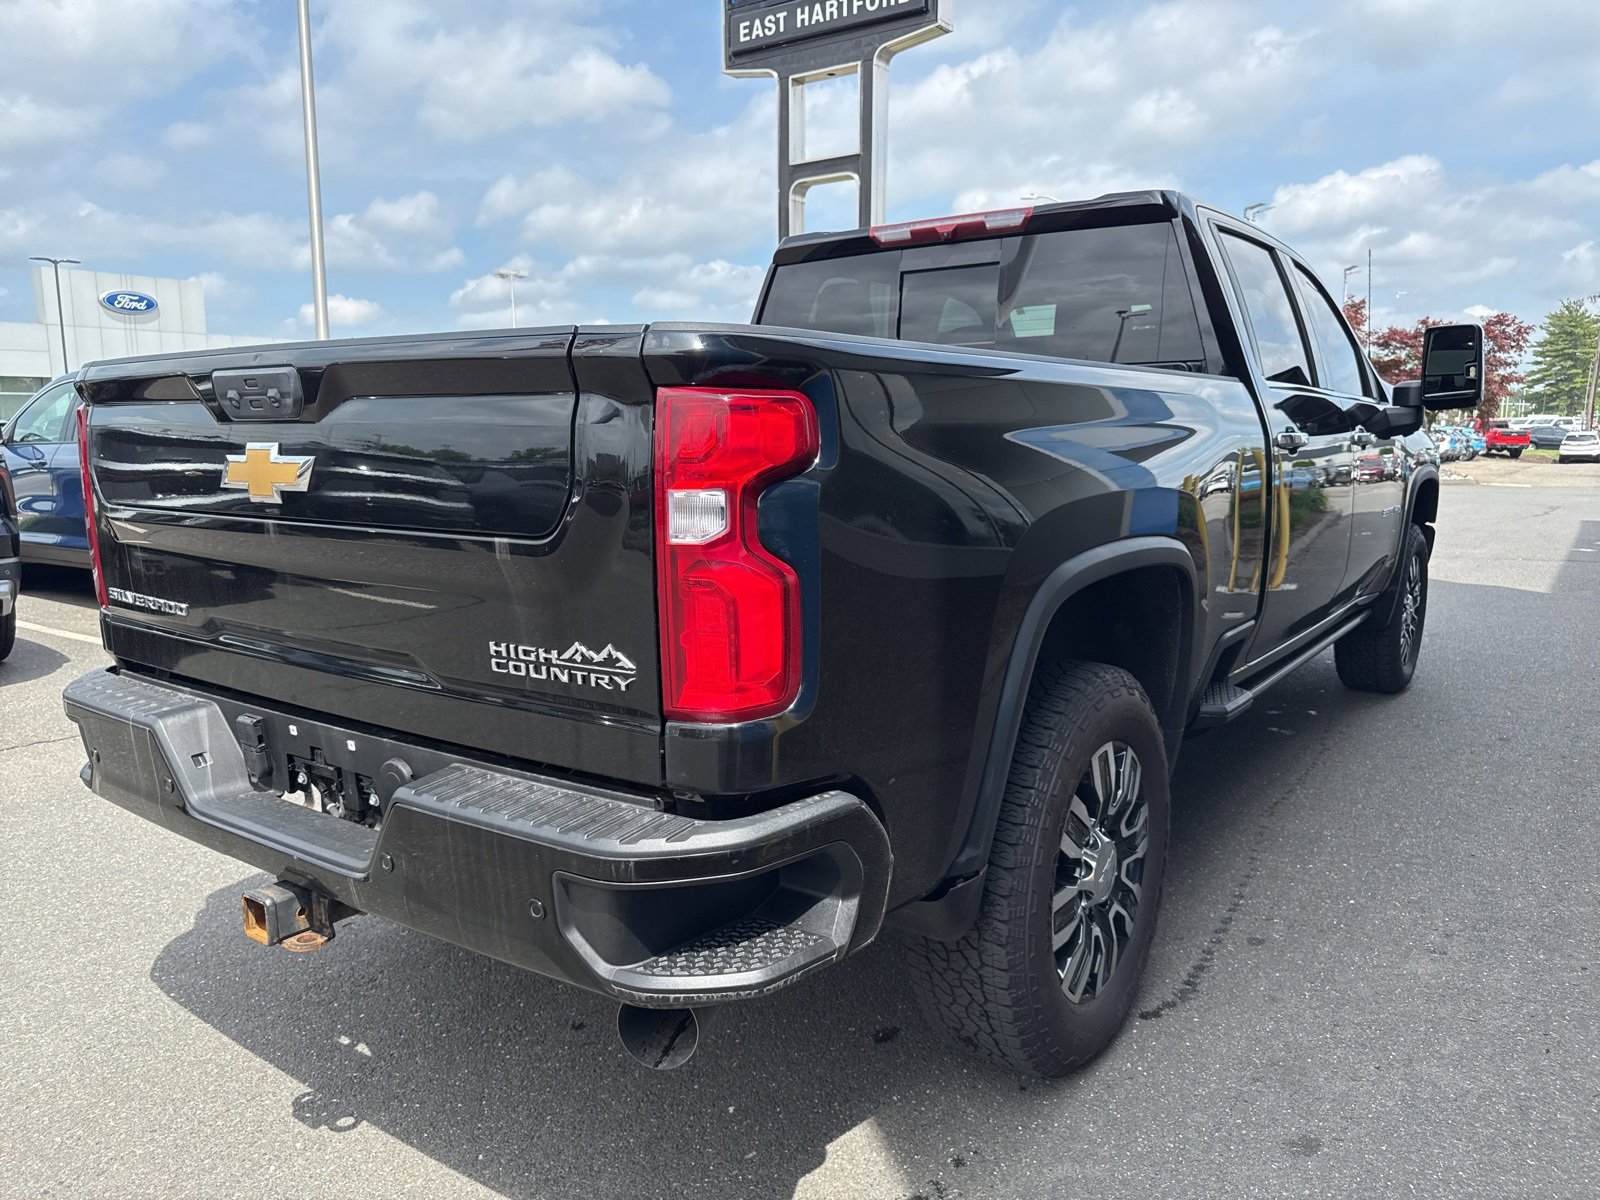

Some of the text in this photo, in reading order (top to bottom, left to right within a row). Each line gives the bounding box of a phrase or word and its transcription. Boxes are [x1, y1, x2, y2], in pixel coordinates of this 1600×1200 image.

[739, 0, 910, 43] EAST HARTFO
[113, 294, 148, 311] Ford
[107, 587, 190, 617] SILVERADO
[489, 641, 559, 664] HIGH
[490, 658, 637, 692] COUNTRY
